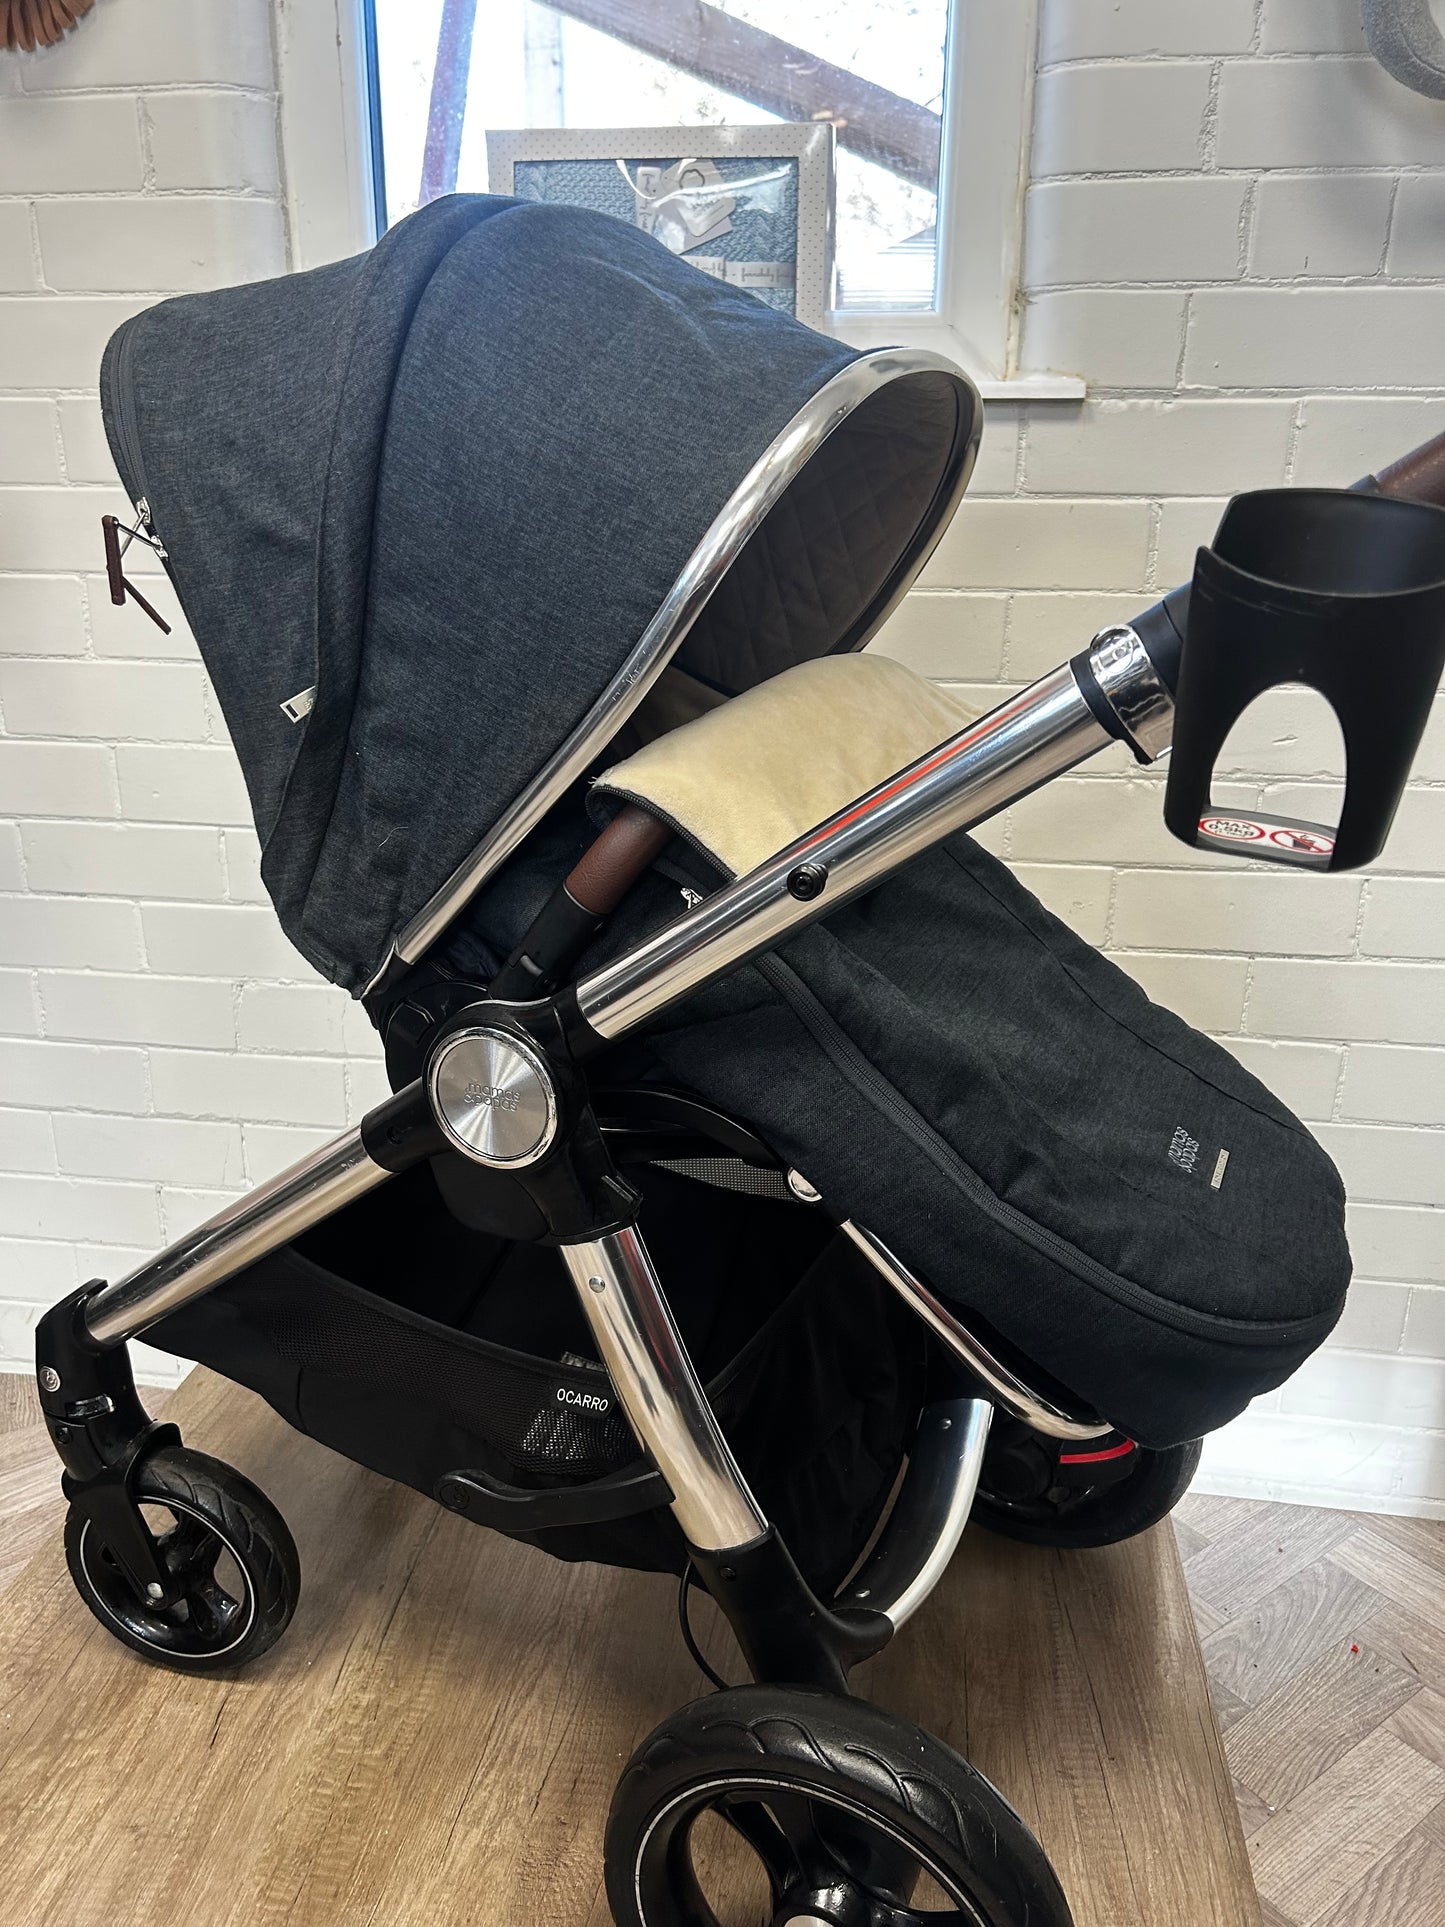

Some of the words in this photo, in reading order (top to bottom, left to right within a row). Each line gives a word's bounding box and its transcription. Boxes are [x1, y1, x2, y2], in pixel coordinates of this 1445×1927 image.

[1215, 820, 1251, 830] MAX
[468, 1082, 521, 1103] mamas
[556, 1388, 608, 1411] OCARRO
